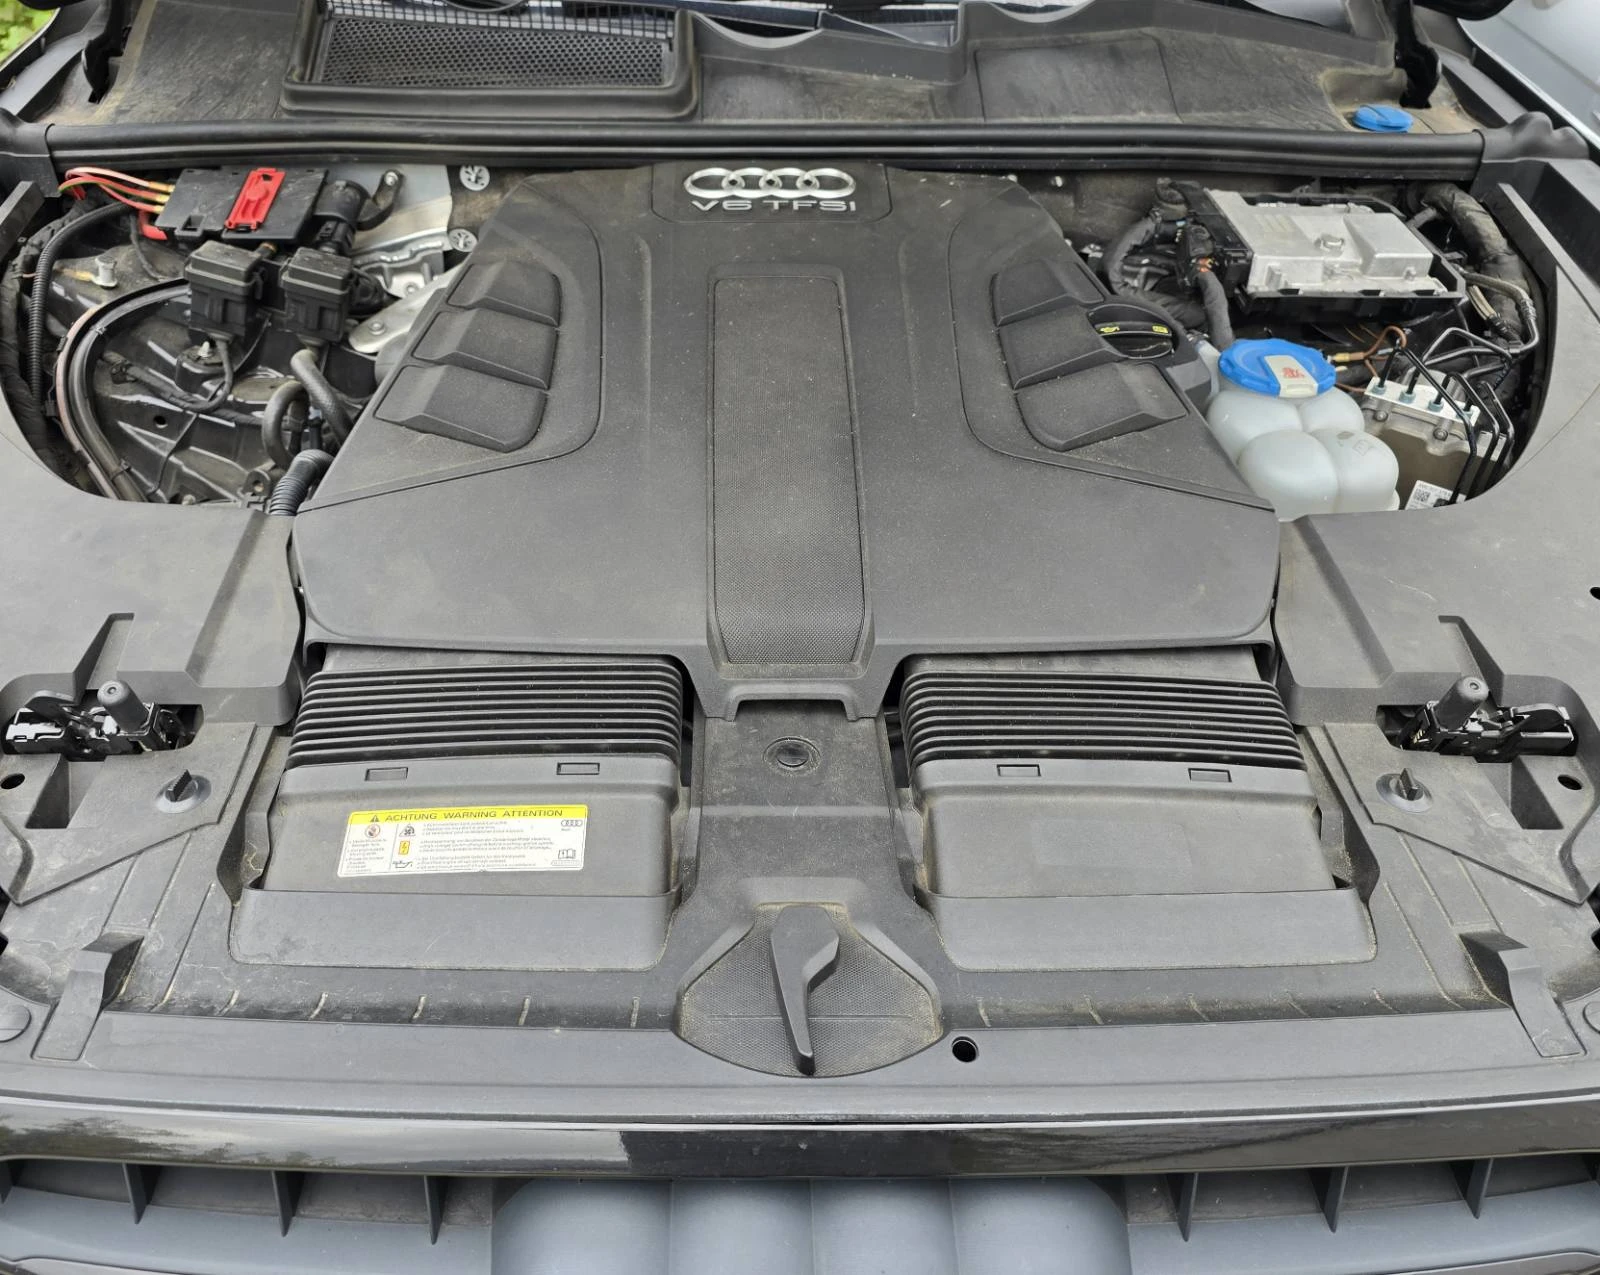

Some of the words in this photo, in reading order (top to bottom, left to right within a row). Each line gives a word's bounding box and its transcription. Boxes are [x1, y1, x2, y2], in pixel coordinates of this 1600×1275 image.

[691, 200, 753, 212] V6
[762, 200, 857, 212] TFSI
[385, 813, 437, 822] ACHTUNG
[444, 810, 497, 819] WARNING
[502, 809, 563, 818] ATTENTION
